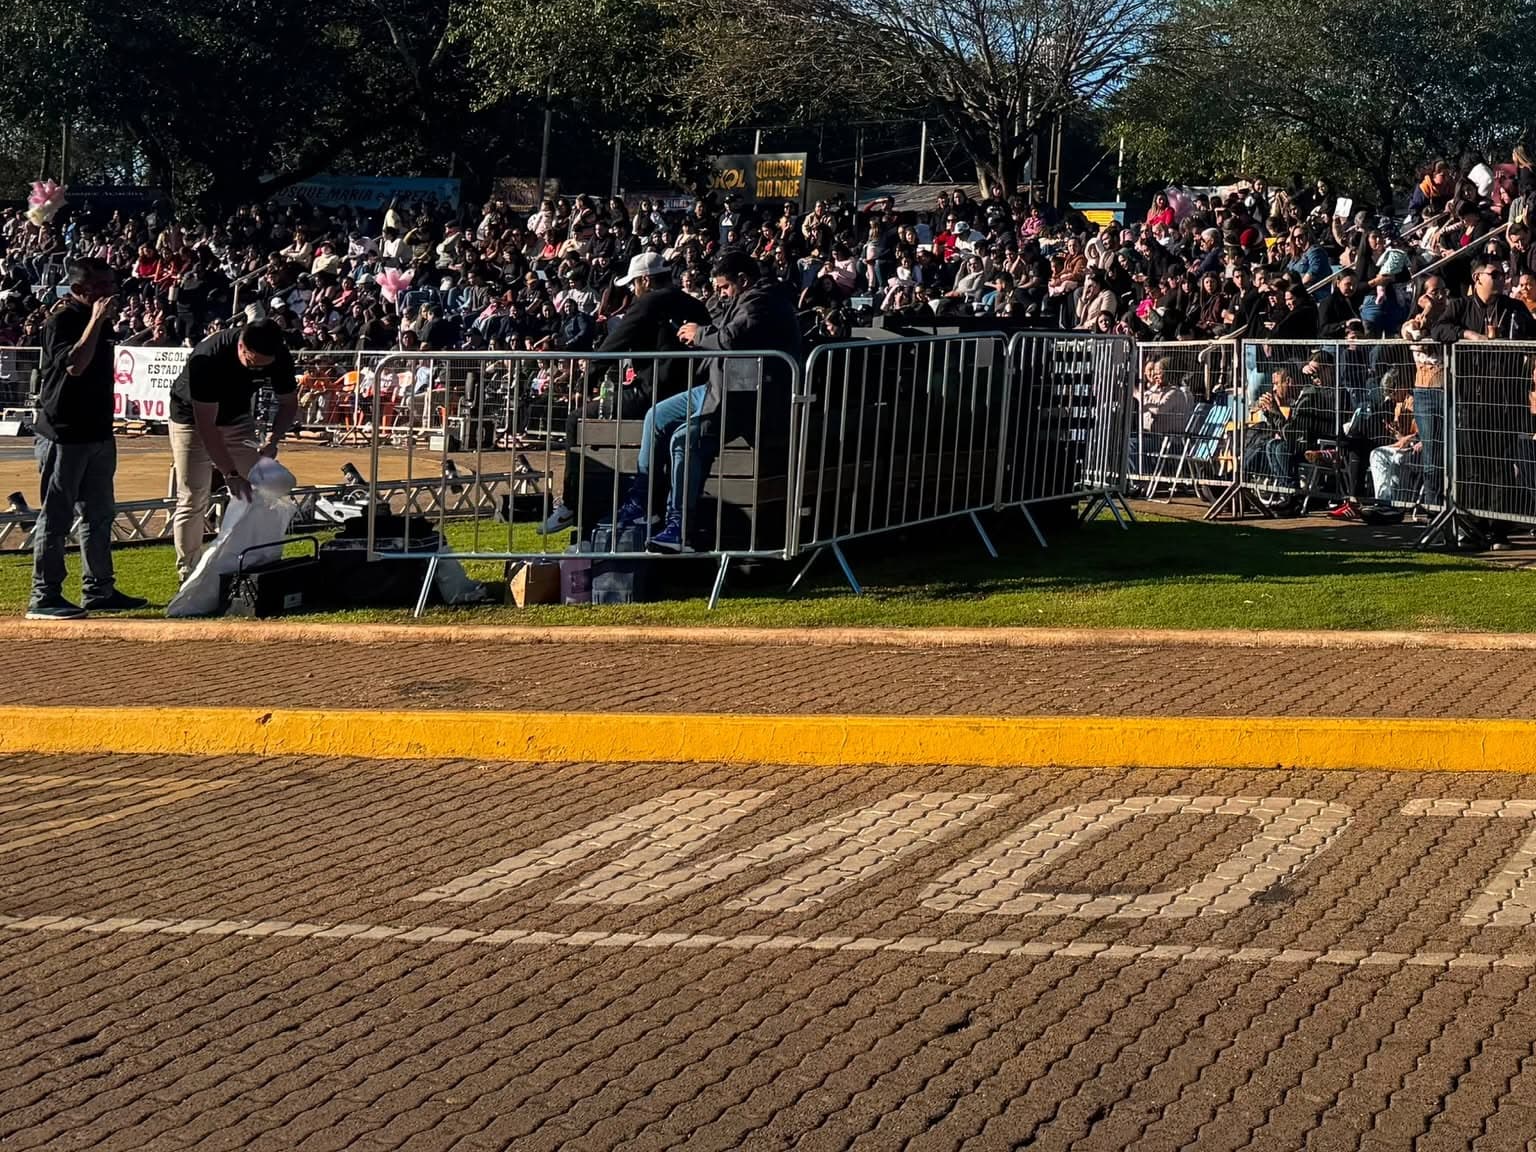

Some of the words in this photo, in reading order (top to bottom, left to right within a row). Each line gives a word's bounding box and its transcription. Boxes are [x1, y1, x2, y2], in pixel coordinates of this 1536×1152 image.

[755, 159, 804, 178] QUIOSQUE
[706, 168, 745, 189] SKOL
[275, 184, 327, 201] OSQUE
[328, 187, 372, 201] MARIA
[756, 180, 773, 198] RIO
[774, 179, 801, 198] DOCE
[154, 351, 188, 362] ESCOL
